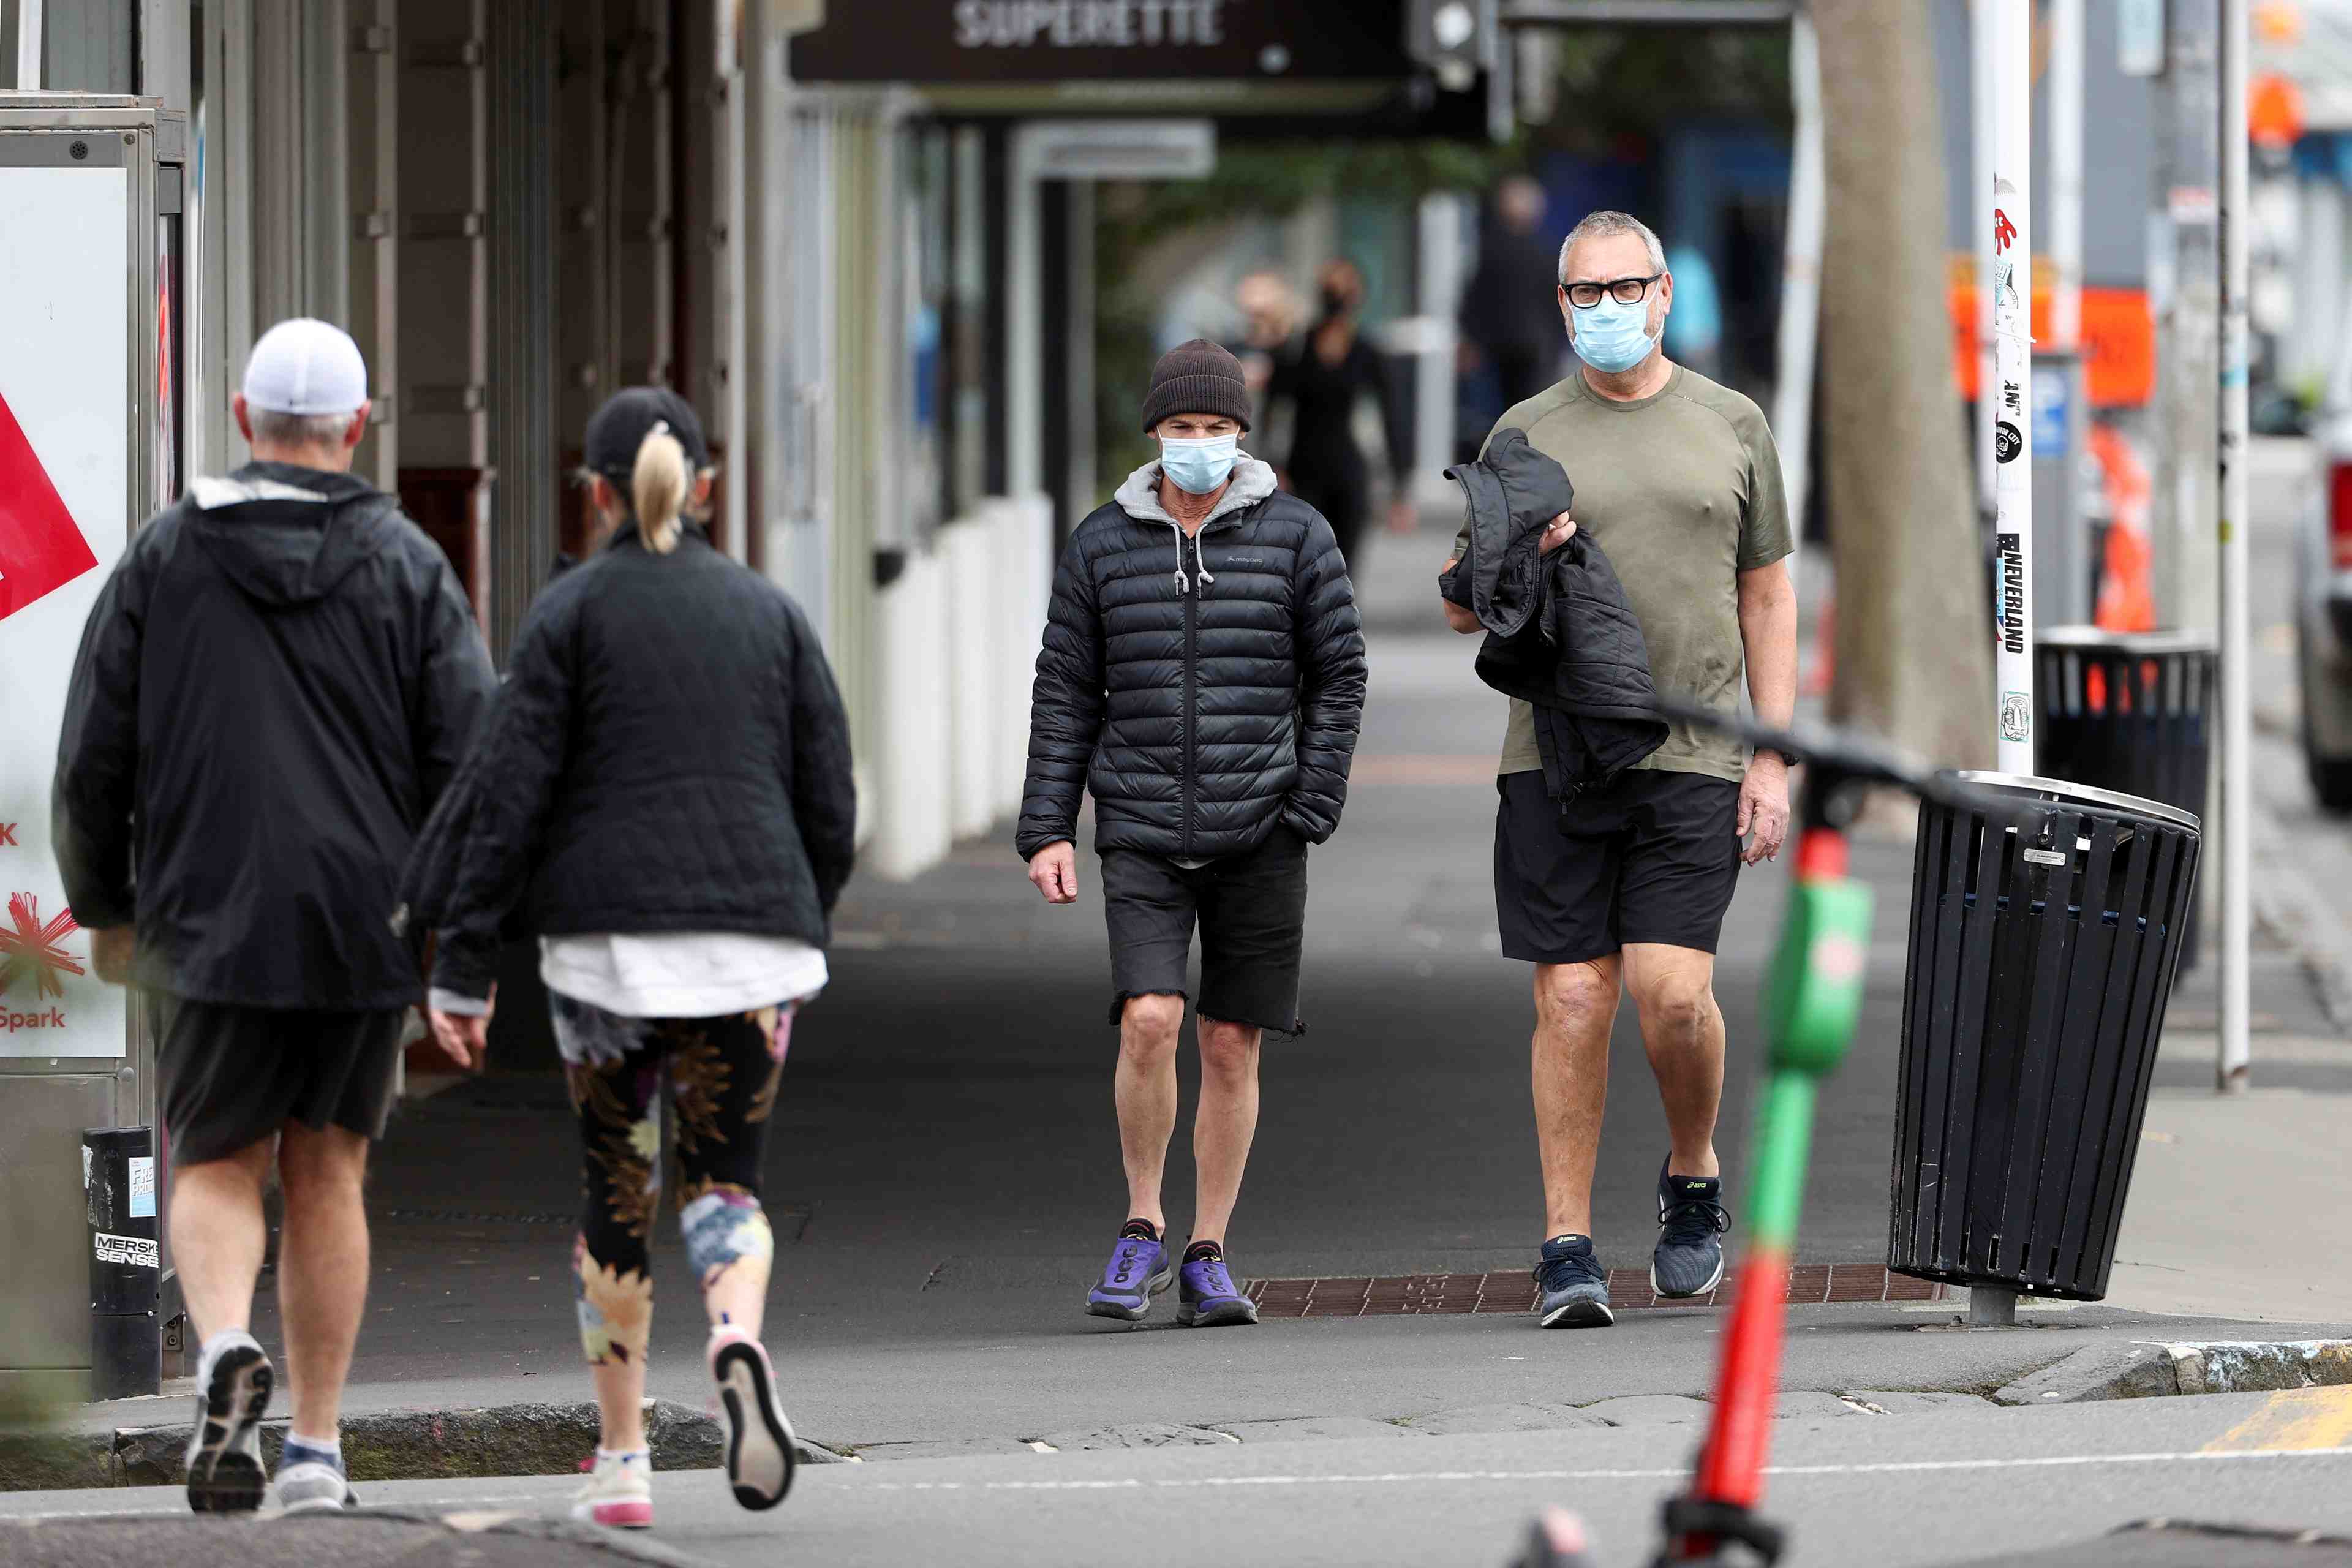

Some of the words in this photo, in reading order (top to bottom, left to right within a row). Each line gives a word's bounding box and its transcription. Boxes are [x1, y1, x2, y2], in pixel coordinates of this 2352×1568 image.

[2008, 432, 2021, 445] CITY
[2004, 552, 2024, 654] NEVERLAND
[0, 1007, 66, 1033] Spark
[97, 1236, 158, 1254] MERSK
